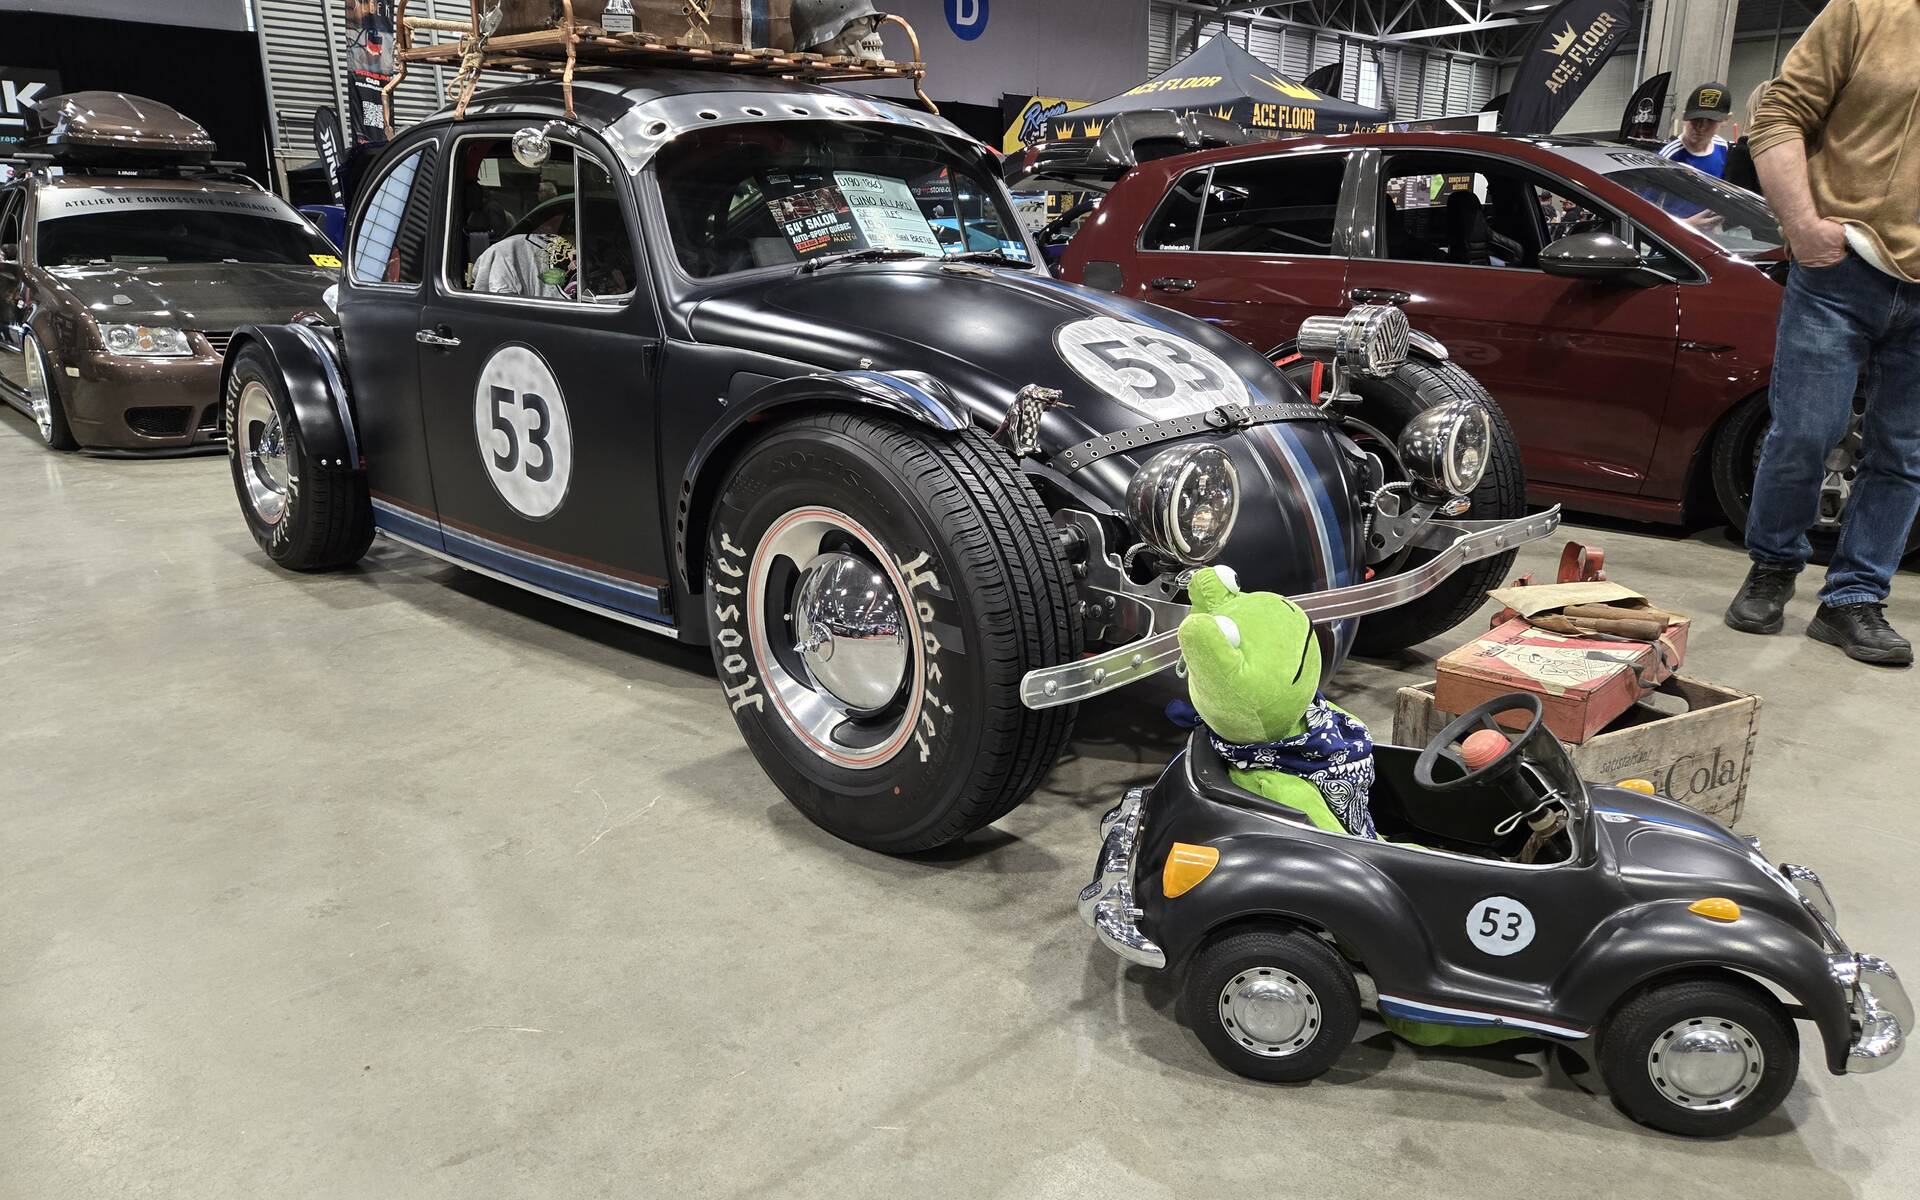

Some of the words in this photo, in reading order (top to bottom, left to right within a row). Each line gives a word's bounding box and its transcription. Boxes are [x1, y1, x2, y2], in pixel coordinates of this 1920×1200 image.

[1545, 60, 1576, 94] ACE
[1568, 12, 1616, 63] FLOOR
[1160, 76, 1223, 93] FLOOR
[1252, 103, 1277, 126] ACE
[1279, 104, 1315, 130] FLOOR
[1338, 123, 1348, 132] BY
[1353, 120, 1377, 134] ACEC
[64, 198, 115, 208] ATELIER
[118, 196, 133, 204] DE
[137, 196, 215, 207] CARROSSERIE
[849, 194, 877, 207] GINO
[880, 197, 913, 210] ALLARD
[792, 227, 830, 244] AUTO-SPORT
[829, 221, 852, 234] QUÉBEC
[805, 212, 838, 230] SALON
[1081, 335, 1225, 400] 53
[490, 384, 554, 483] 53
[708, 532, 764, 714] Hoosier
[894, 551, 954, 763] Hoosier
[1479, 906, 1522, 942] 53
